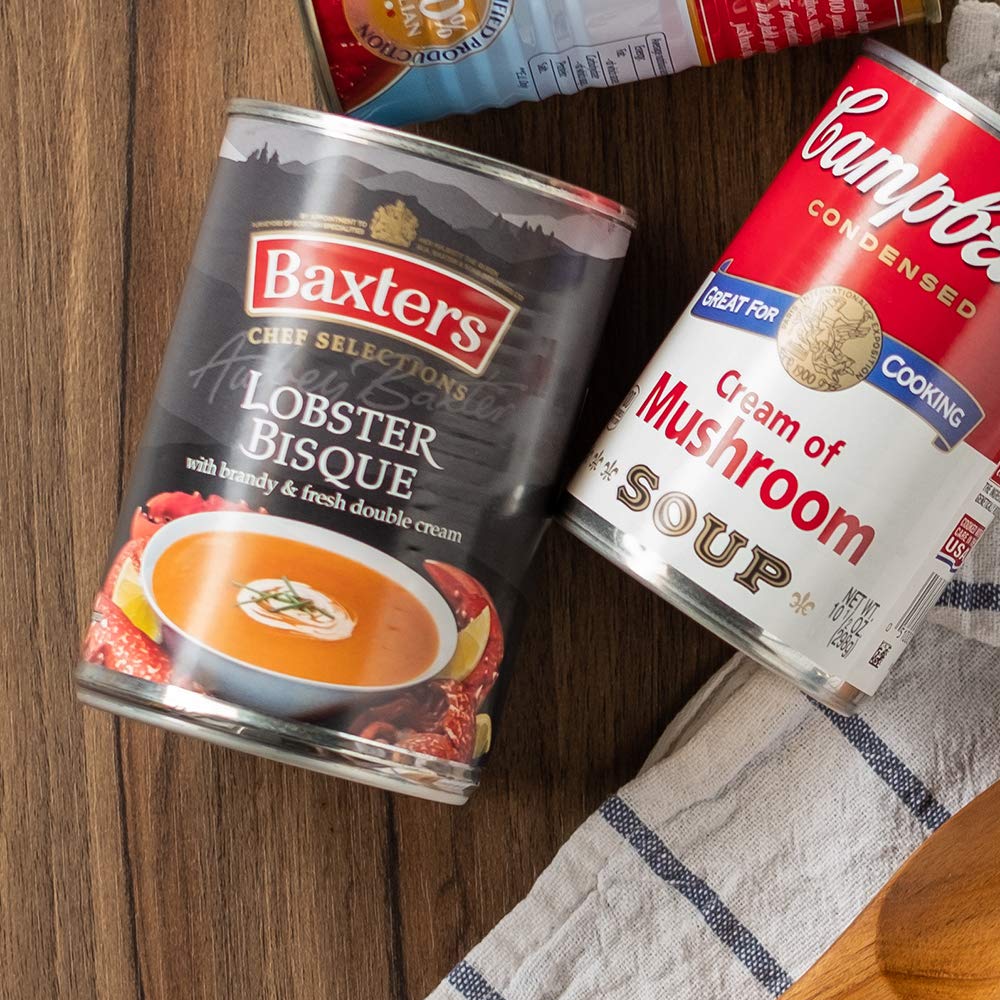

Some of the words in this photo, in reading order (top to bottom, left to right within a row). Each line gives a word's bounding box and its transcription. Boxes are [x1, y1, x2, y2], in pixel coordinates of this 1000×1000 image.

[357, 23, 482, 64] PRODUCTION
[263, 248, 489, 353] Baxters
[807, 198, 978, 320] CONDENSED
[701, 285, 745, 315] GREAT
[744, 299, 779, 323] FOR
[247, 327, 309, 346] CHEF
[315, 331, 470, 401] SELECTIONS
[792, 363, 817, 385] 1900
[880, 354, 968, 430] COOKING
[239, 417, 418, 500] BISQUE
[240, 369, 445, 470] LOBSTER
[716, 369, 802, 443] Cream
[804, 437, 847, 468] of
[185, 455, 217, 477] with
[218, 462, 279, 496] brandy
[280, 480, 299, 497] &
[301, 484, 347, 511] fresh
[349, 494, 413, 529] double
[414, 519, 463, 544] cream
[635, 370, 877, 567] Mushroom
[616, 463, 793, 596] SOUP
[828, 602, 845, 622] 10
[842, 586, 868, 612] NET
[861, 598, 881, 622] WT.
